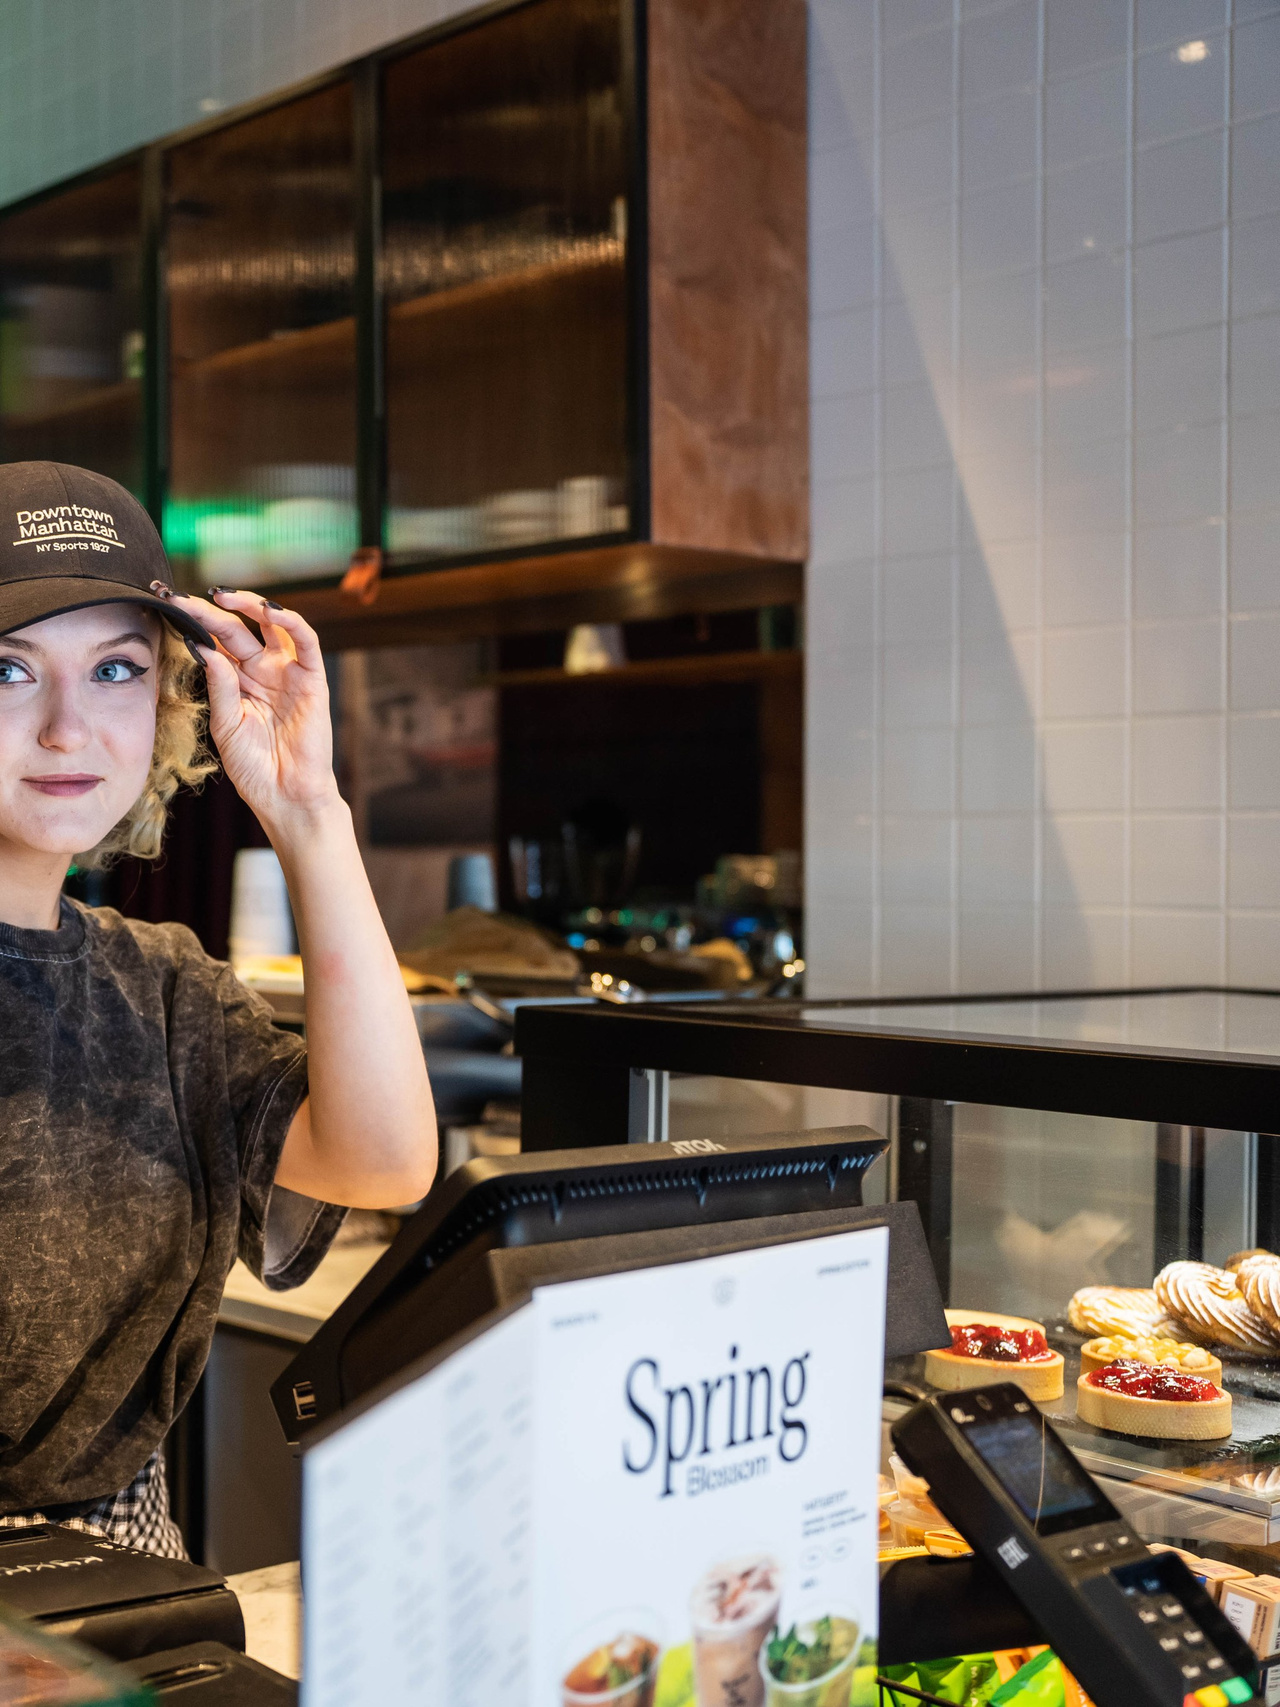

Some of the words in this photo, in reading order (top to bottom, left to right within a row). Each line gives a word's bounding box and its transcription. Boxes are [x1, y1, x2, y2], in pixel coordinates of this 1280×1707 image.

[16, 504, 114, 526] Downtown
[19, 517, 118, 540] Manhattan
[36, 543, 51, 552] NY
[53, 541, 89, 553] Sports
[90, 542, 110, 553] 1927
[622, 1345, 811, 1499] Spring
